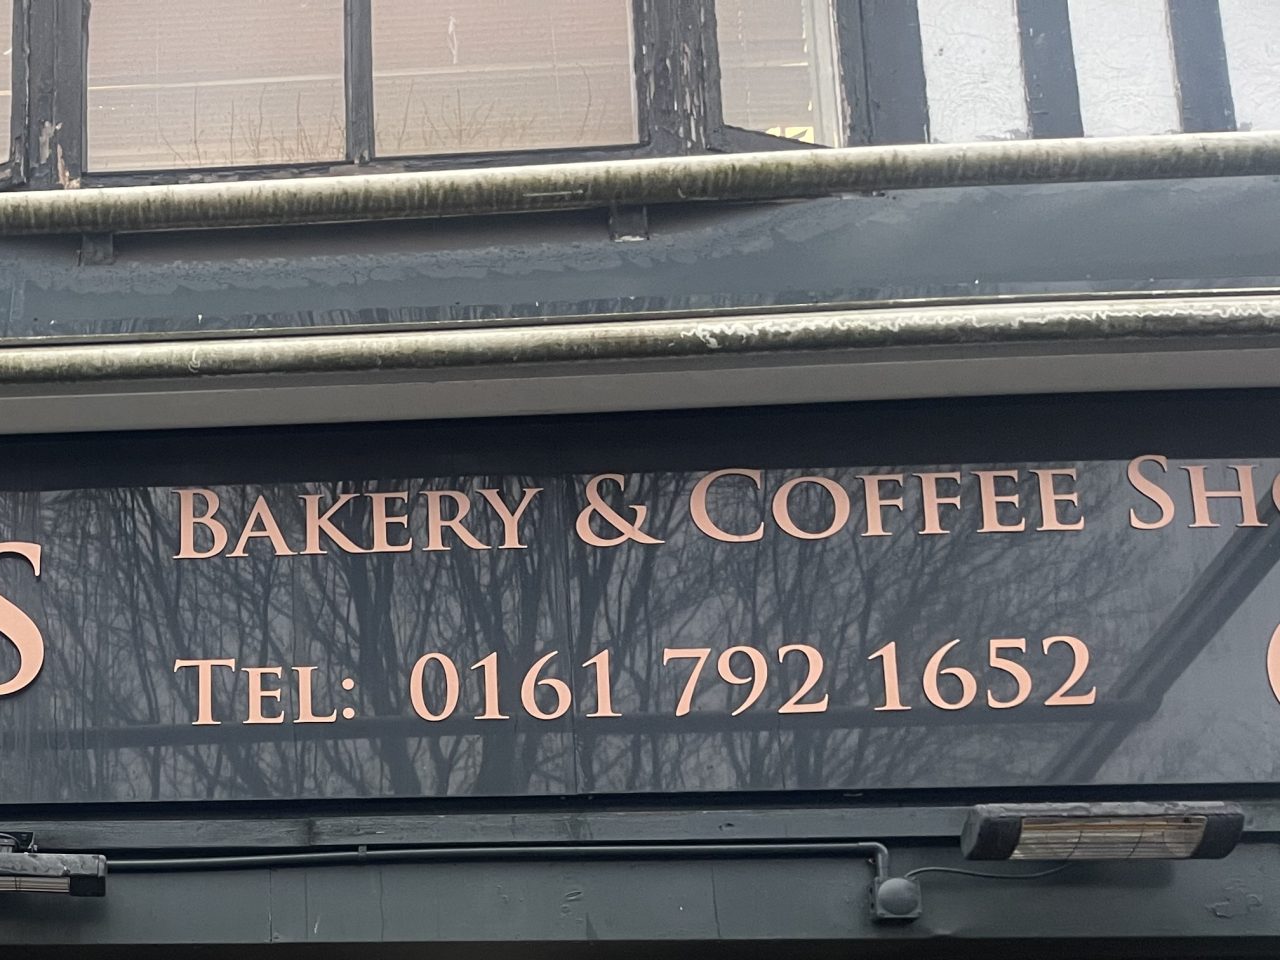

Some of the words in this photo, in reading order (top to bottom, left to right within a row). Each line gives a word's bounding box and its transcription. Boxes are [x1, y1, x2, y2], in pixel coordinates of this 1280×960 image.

[171, 487, 544, 560] BAKERY
[575, 473, 666, 548] &
[689, 467, 1085, 544] COFFEE
[1126, 454, 1280, 531] SH
[173, 658, 356, 726] TEL:
[409, 648, 622, 722] 0161
[662, 644, 829, 717] 792
[867, 635, 1097, 711] 1652
